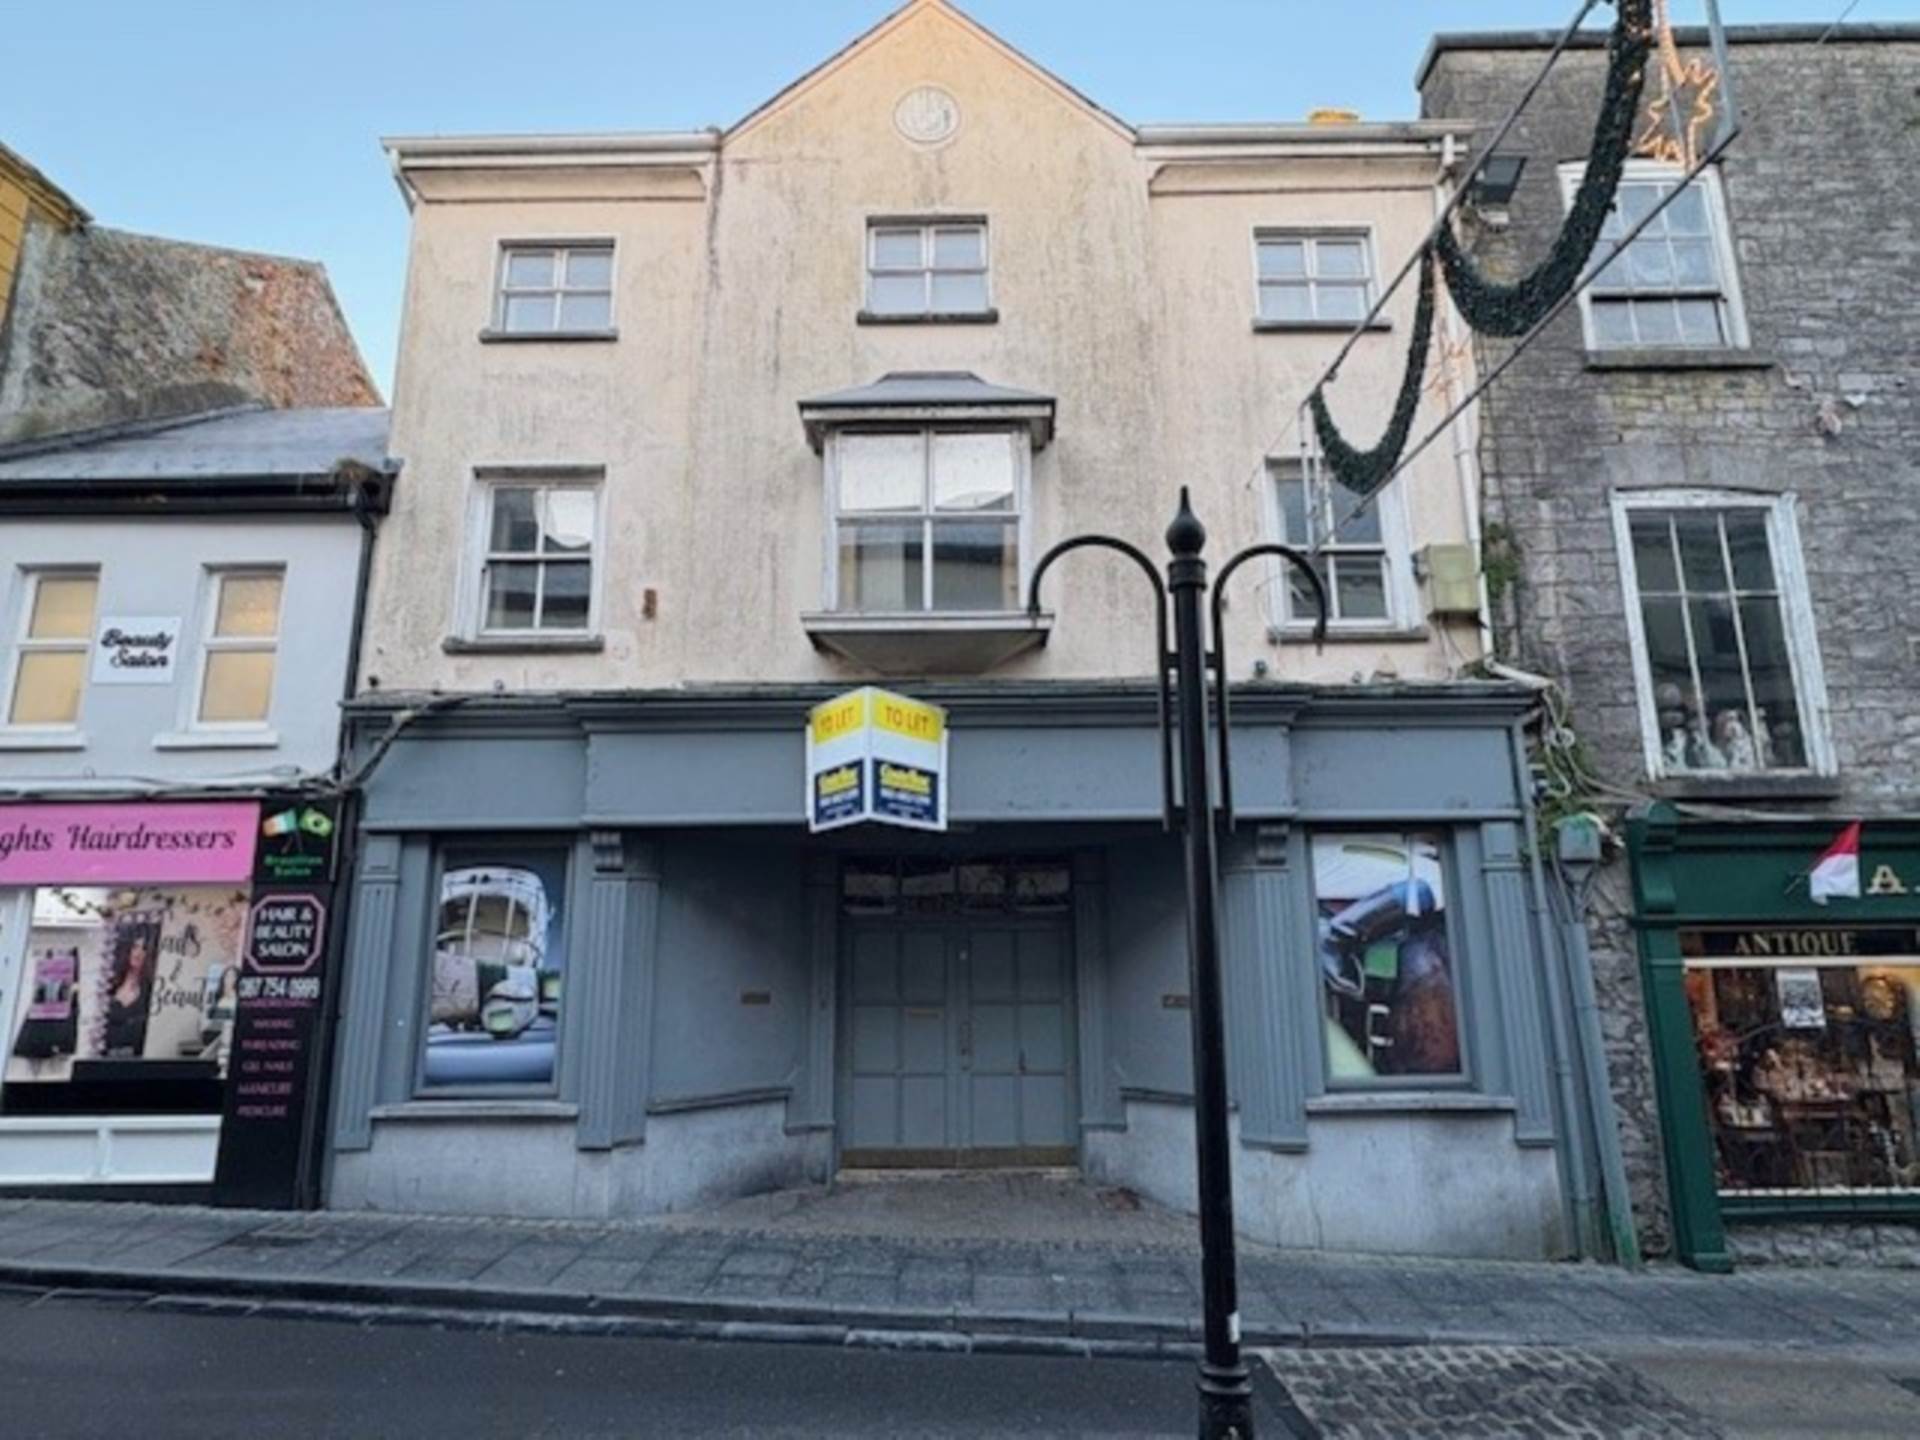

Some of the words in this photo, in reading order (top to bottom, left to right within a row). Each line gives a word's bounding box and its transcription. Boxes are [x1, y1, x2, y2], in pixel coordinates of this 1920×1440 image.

[101, 628, 174, 651] Beauty
[109, 650, 168, 669] Salon
[886, 706, 902, 727] TO
[907, 713, 929, 733] LET
[67, 822, 236, 851] Hairdressers
[260, 907, 297, 921] HAIR
[301, 907, 313, 921] &
[256, 926, 314, 939] BEAUTY
[258, 943, 309, 957] SALON
[1734, 931, 1857, 956] ANTIQUE
